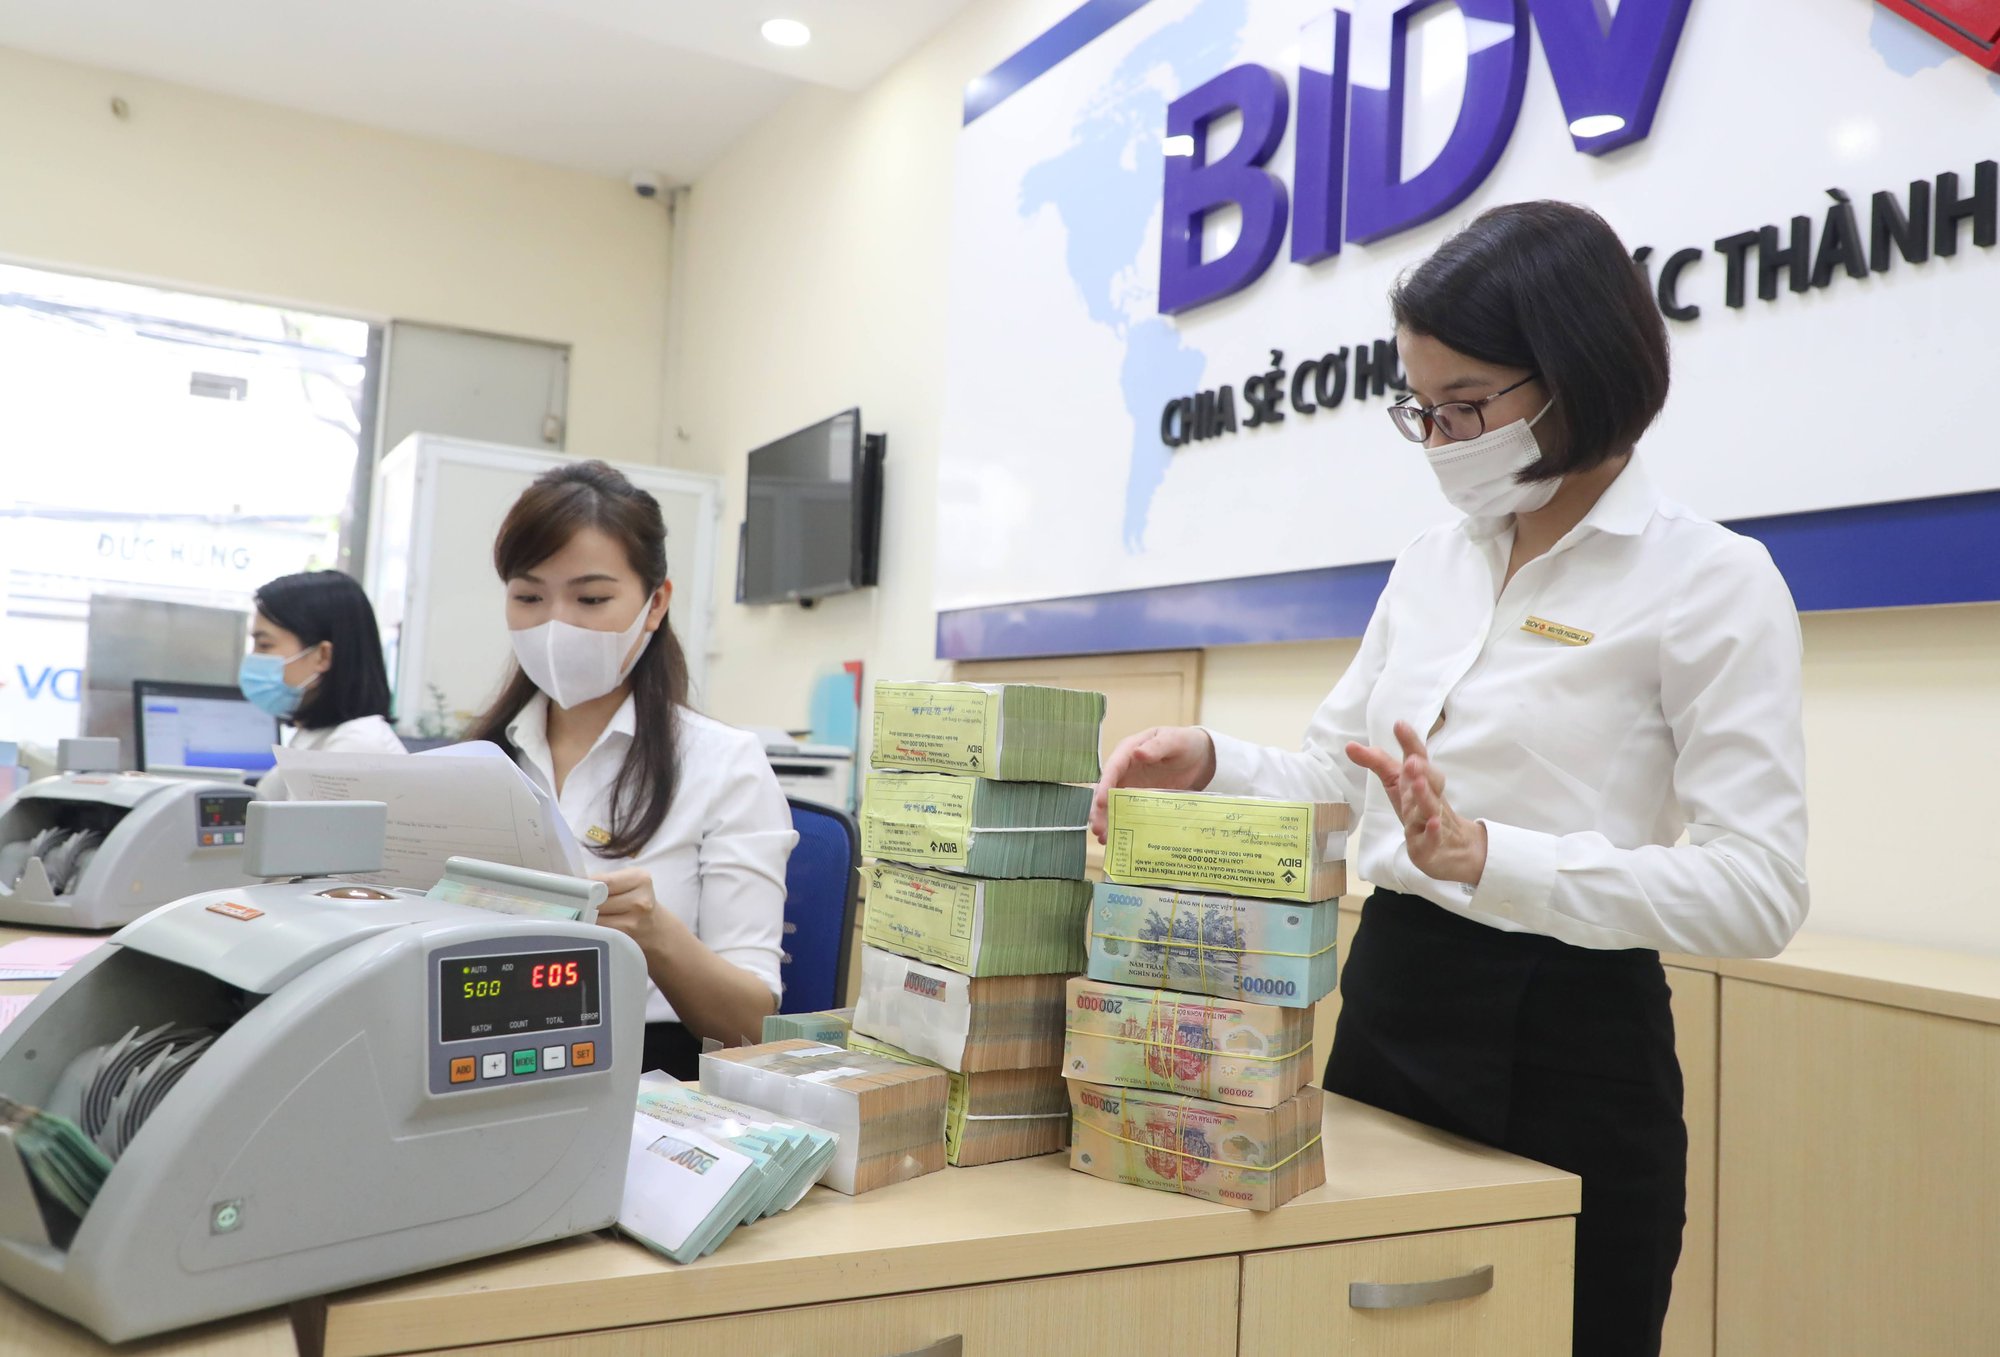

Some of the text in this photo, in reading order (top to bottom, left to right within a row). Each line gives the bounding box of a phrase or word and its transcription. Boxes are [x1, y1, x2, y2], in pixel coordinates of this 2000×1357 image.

[1158, 0, 1691, 315] BIDV
[1161, 385, 1237, 447] CHIA
[1242, 349, 1285, 428] SẺ
[1291, 346, 1349, 414] CƠ
[1714, 159, 1998, 309] THÀNH
[967, 745, 982, 753] BIDV
[939, 843, 957, 853] BIDV
[1188, 855, 1217, 863] 200.000
[1278, 858, 1302, 868] BIDV
[470, 965, 488, 974] AUTO
[501, 963, 514, 972] ADD
[531, 962, 578, 989] E05
[463, 980, 501, 999] 500
[1233, 975, 1297, 997] 500000
[1077, 995, 1123, 1014] 200000
[545, 1017, 564, 1025] TOTAL
[580, 1012, 599, 1020] ERROR
[471, 1024, 492, 1033] BATCH
[509, 1020, 529, 1029] COUNT
[576, 1049, 591, 1059] SET
[1218, 1086, 1254, 1097] 200000
[1081, 1091, 1120, 1115] 200000
[1219, 1189, 1254, 1200] 200000
